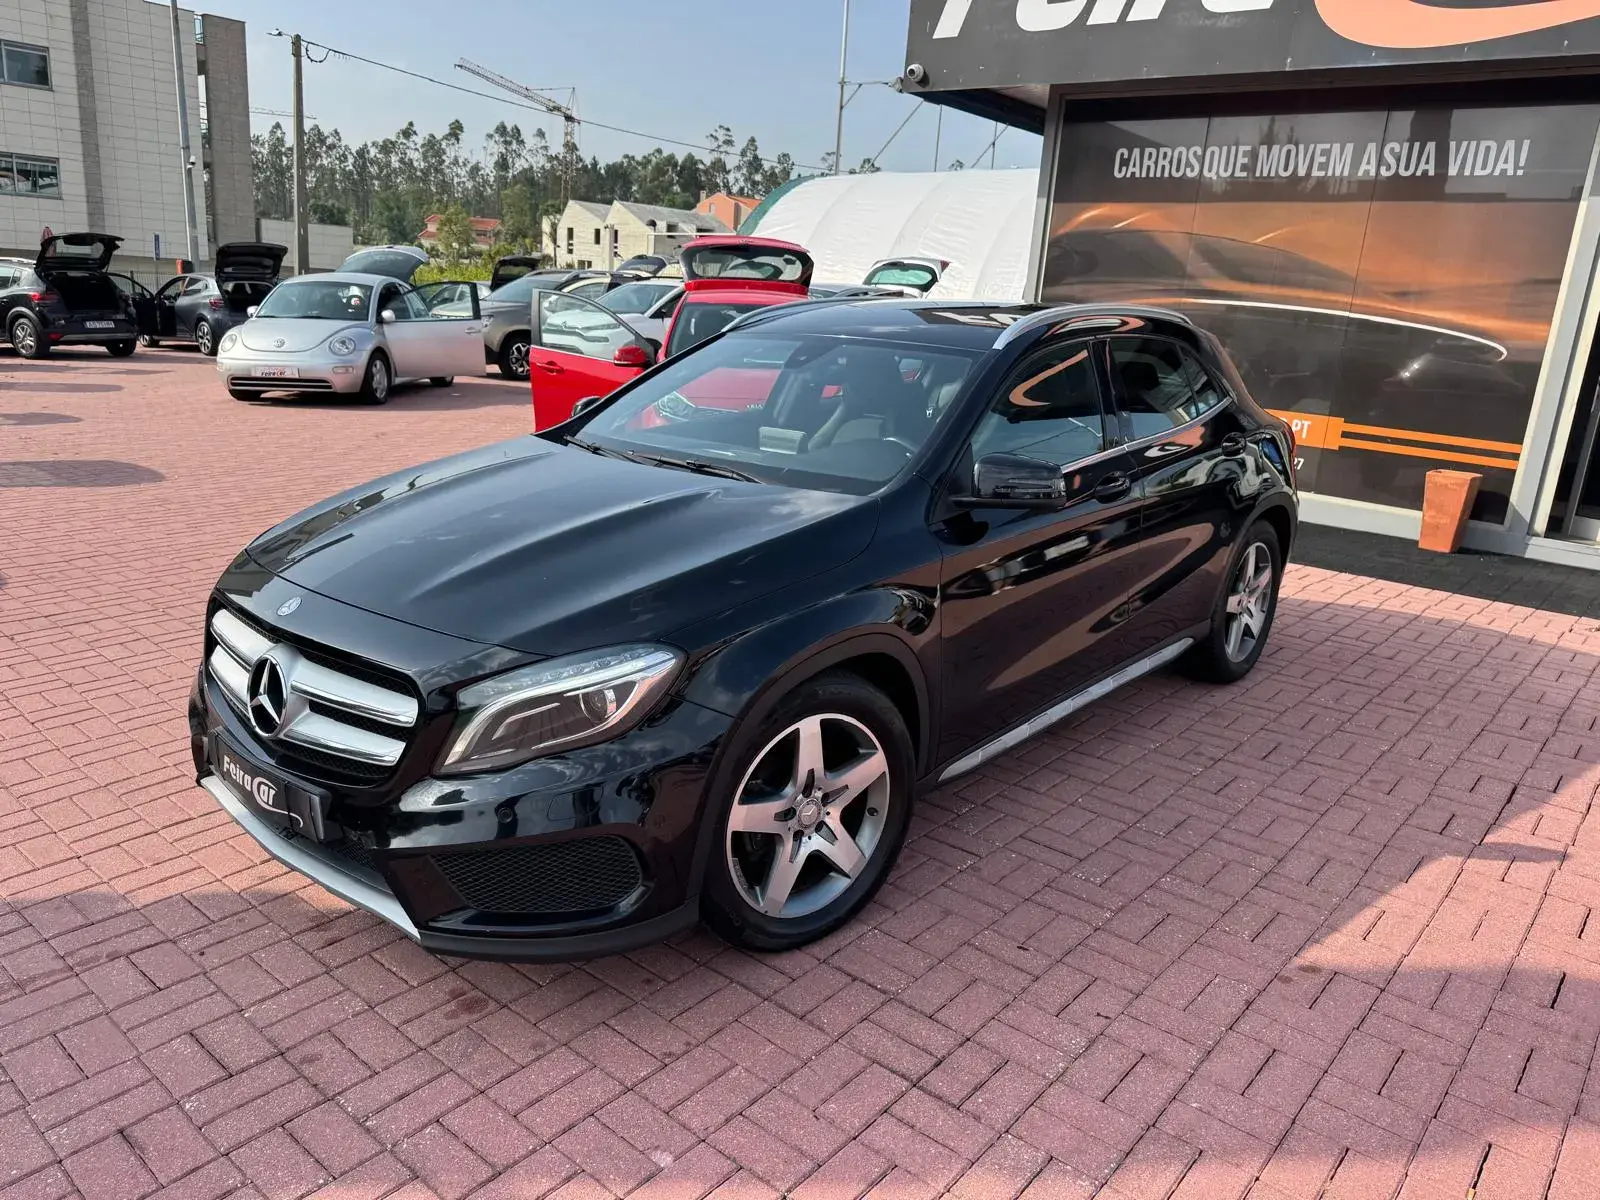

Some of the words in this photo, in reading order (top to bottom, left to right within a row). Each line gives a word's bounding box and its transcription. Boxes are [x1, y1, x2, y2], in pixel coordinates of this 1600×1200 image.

[1114, 146, 1202, 178] CARROS
[1202, 145, 1252, 179] QUE
[1255, 143, 1353, 177] MOVEM
[1448, 140, 1530, 176] VIDA!
